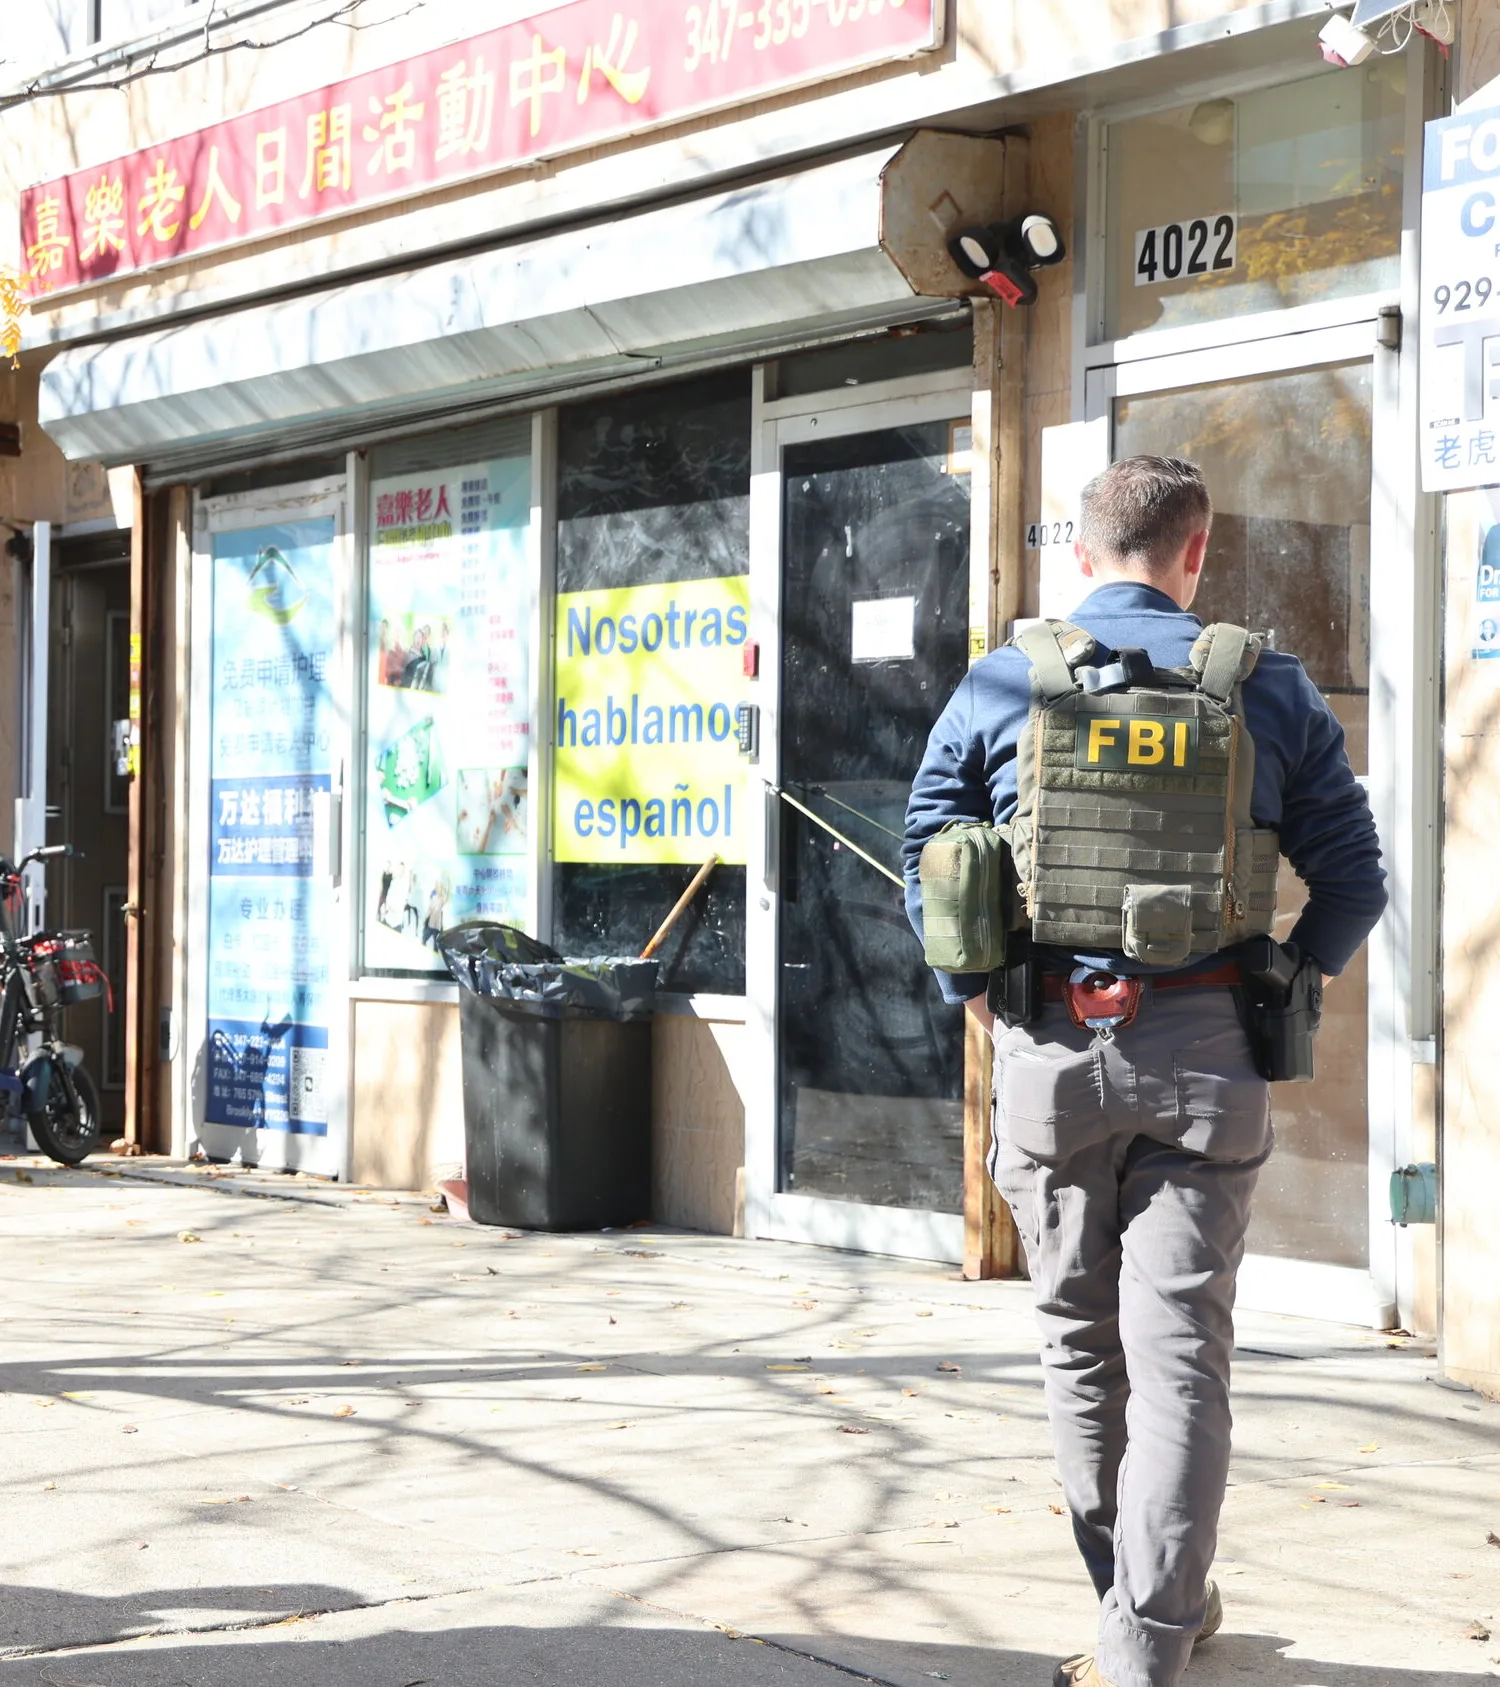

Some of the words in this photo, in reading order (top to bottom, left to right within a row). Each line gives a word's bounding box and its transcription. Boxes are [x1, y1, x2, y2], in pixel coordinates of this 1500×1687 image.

[26, 12, 652, 276] 嘉樂老人日間活動中心
[1137, 214, 1235, 283] 4022
[376, 483, 452, 528] 嘉樂老人
[1027, 520, 1074, 548] 4022
[567, 600, 747, 658] Nosotras
[1087, 719, 1187, 767] FBI
[573, 784, 732, 849] español
